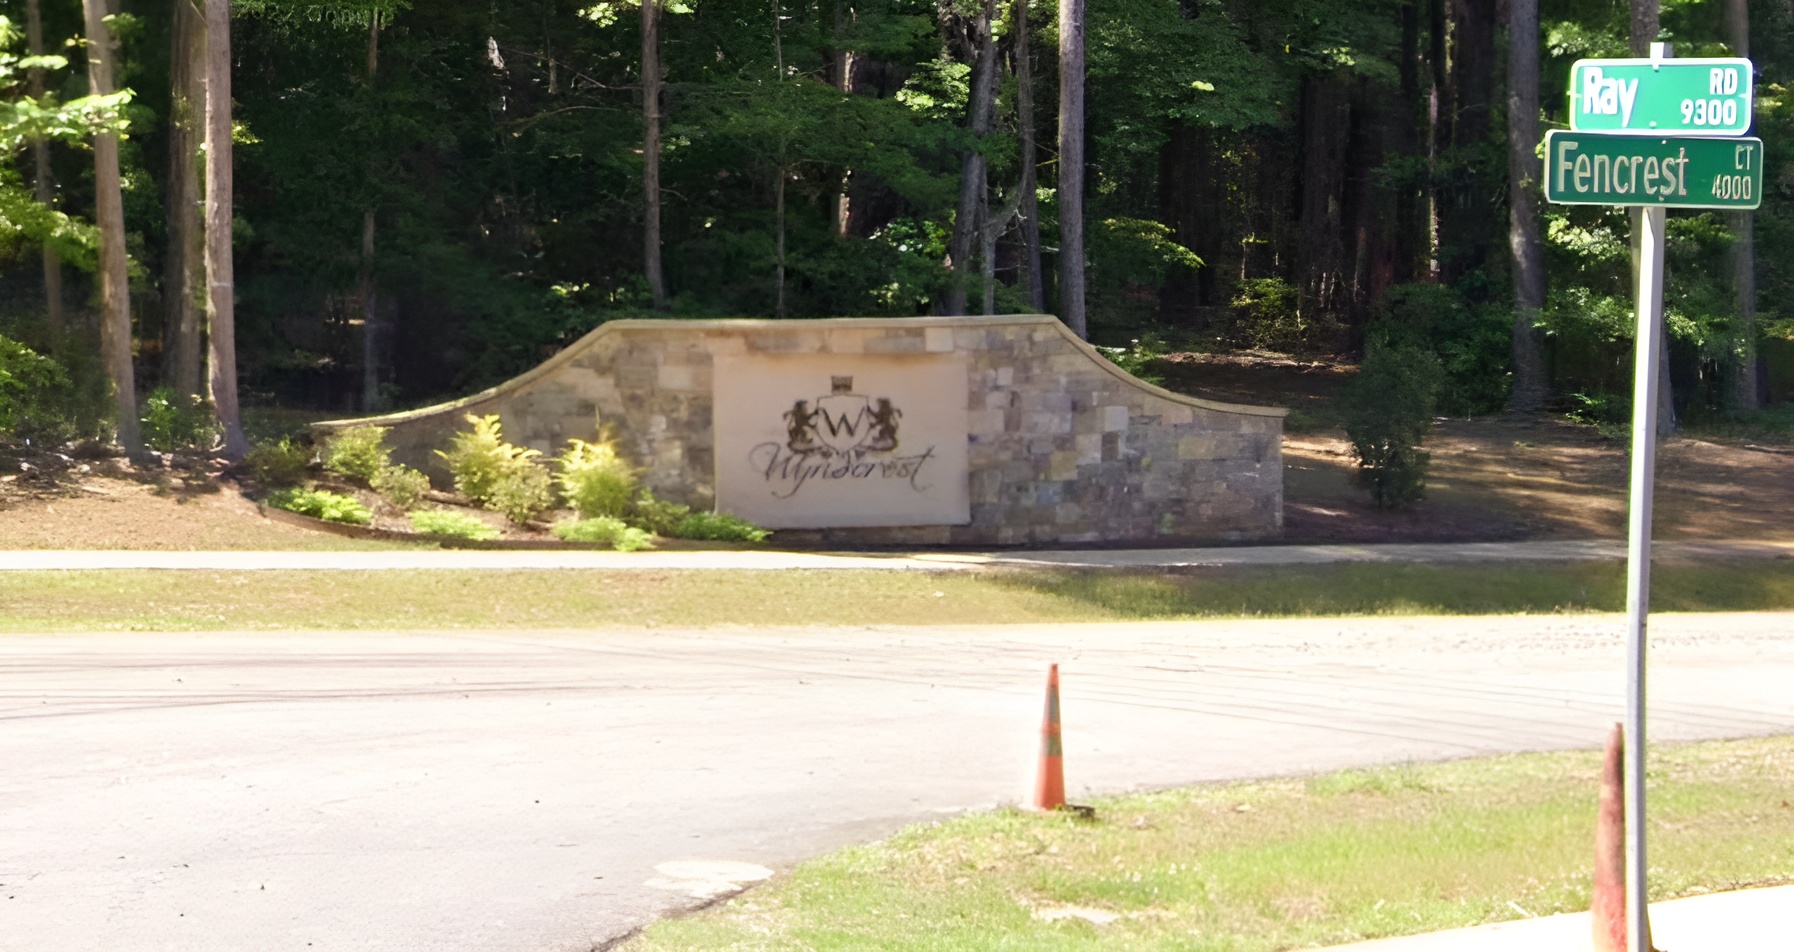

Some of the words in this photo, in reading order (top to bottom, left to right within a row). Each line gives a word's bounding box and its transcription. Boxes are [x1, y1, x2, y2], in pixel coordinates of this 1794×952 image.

[1583, 66, 1638, 128] Ray
[1709, 68, 1738, 95] RD
[1680, 98, 1737, 126] 9300
[1557, 141, 1689, 196] Fencrest
[1735, 145, 1754, 170] CT
[1711, 175, 1752, 200] 4000
[820, 406, 866, 437] W
